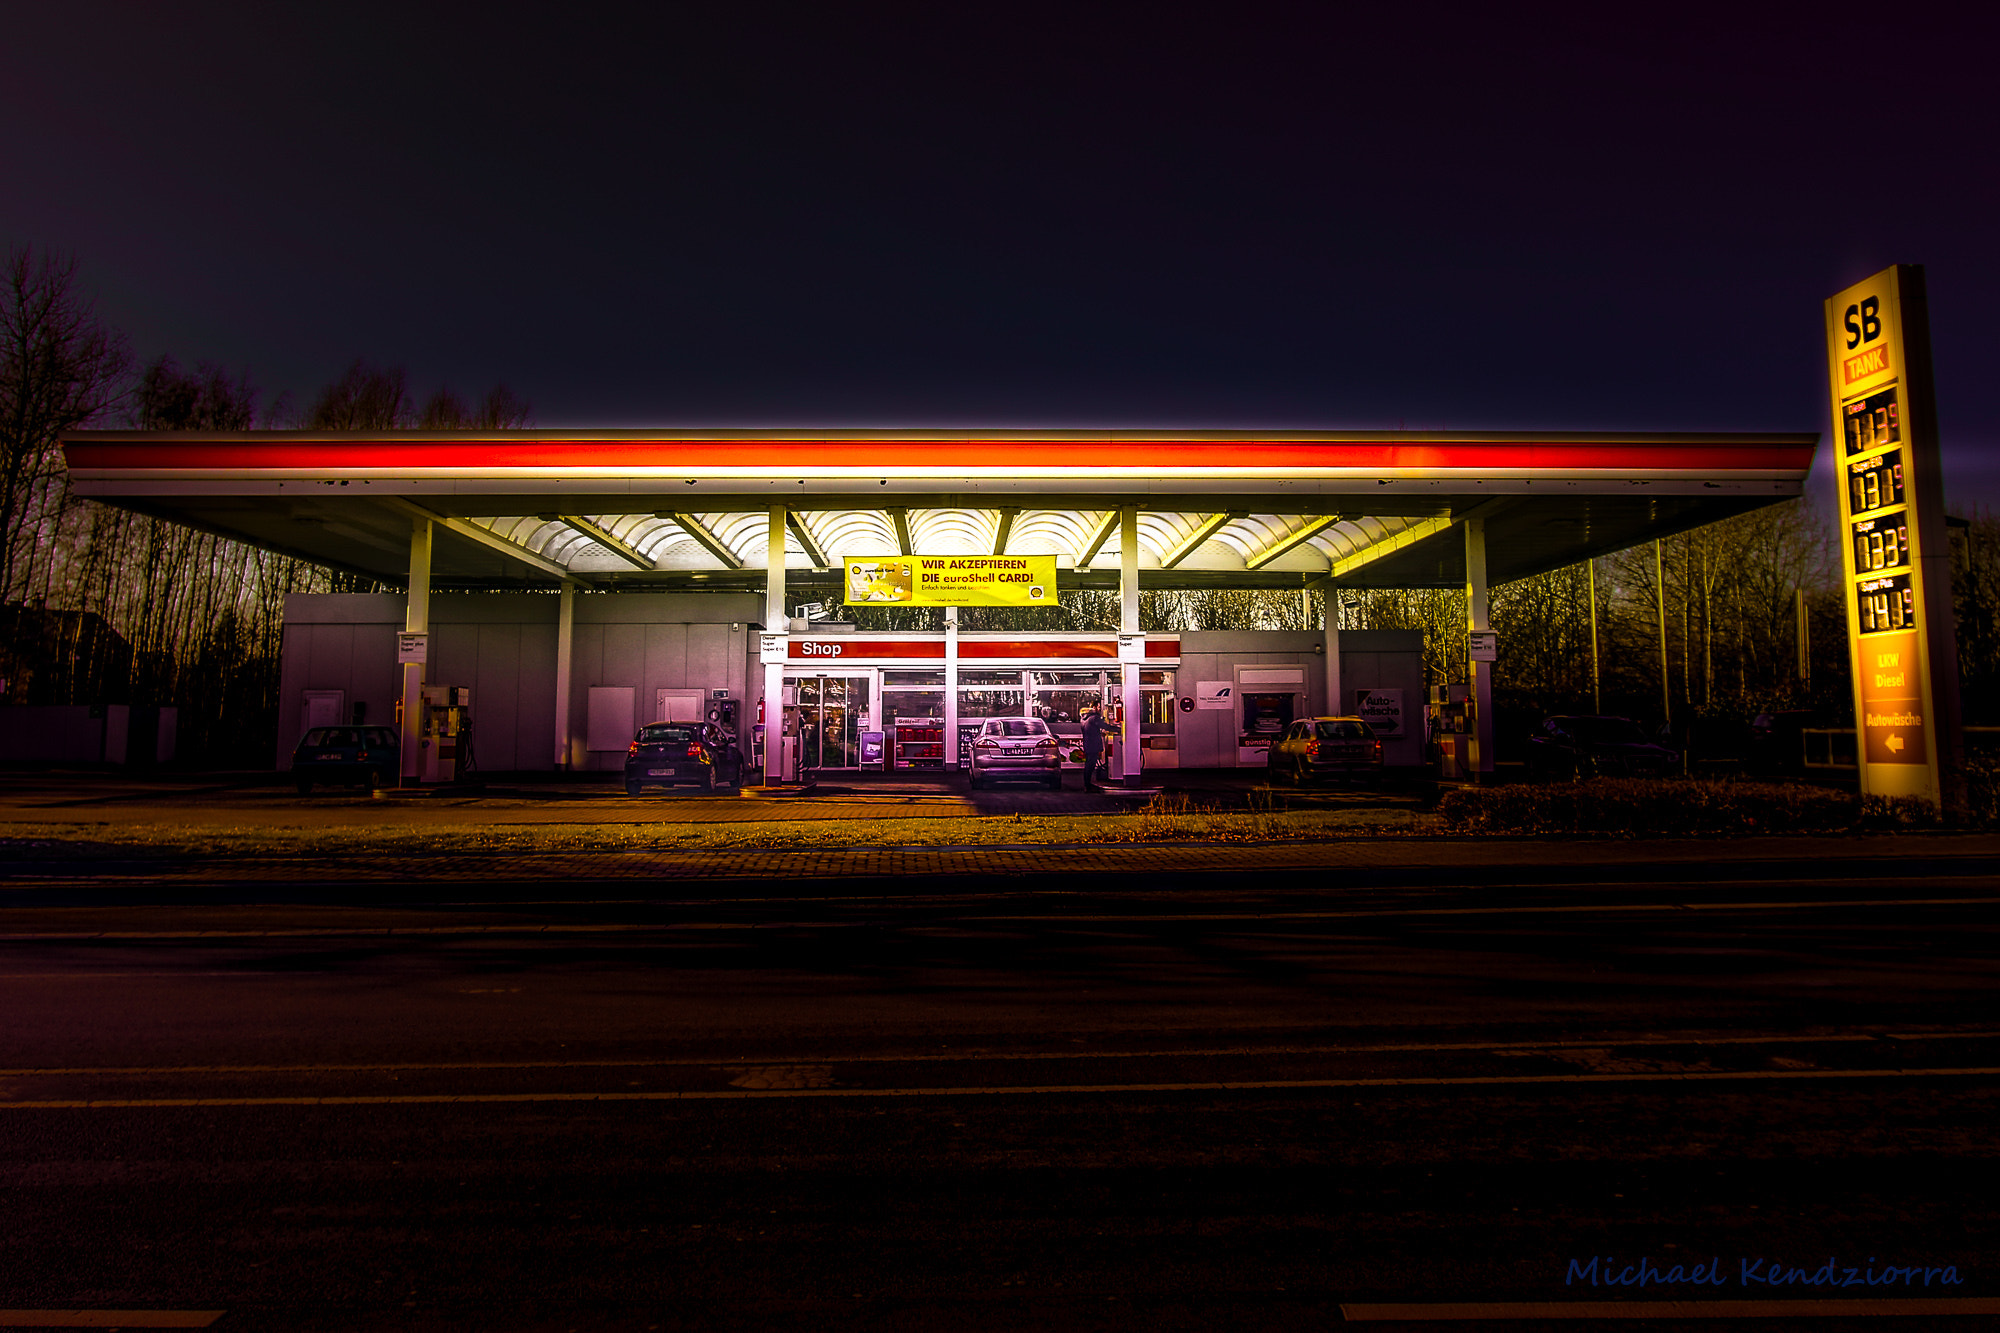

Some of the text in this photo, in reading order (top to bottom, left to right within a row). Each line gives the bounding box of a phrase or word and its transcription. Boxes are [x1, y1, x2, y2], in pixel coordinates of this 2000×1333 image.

[1844, 295, 1881, 350] SB
[1847, 349, 1884, 379] TANK
[1849, 401, 1866, 415] Diesel
[1852, 460, 1869, 474] Super
[1857, 521, 1875, 532] Super
[921, 559, 1027, 569] WIR AKZEPTIEREN
[921, 573, 1034, 583] DIE euroShell CARD!
[1860, 577, 1894, 593] Super Plus
[802, 641, 842, 658] Shop
[1878, 653, 1900, 668] LKW
[1876, 672, 1905, 688] Diesel
[1366, 696, 1395, 706] Auto-
[1360, 706, 1400, 716] wäsche
[1866, 711, 1922, 727] Autowäsche
